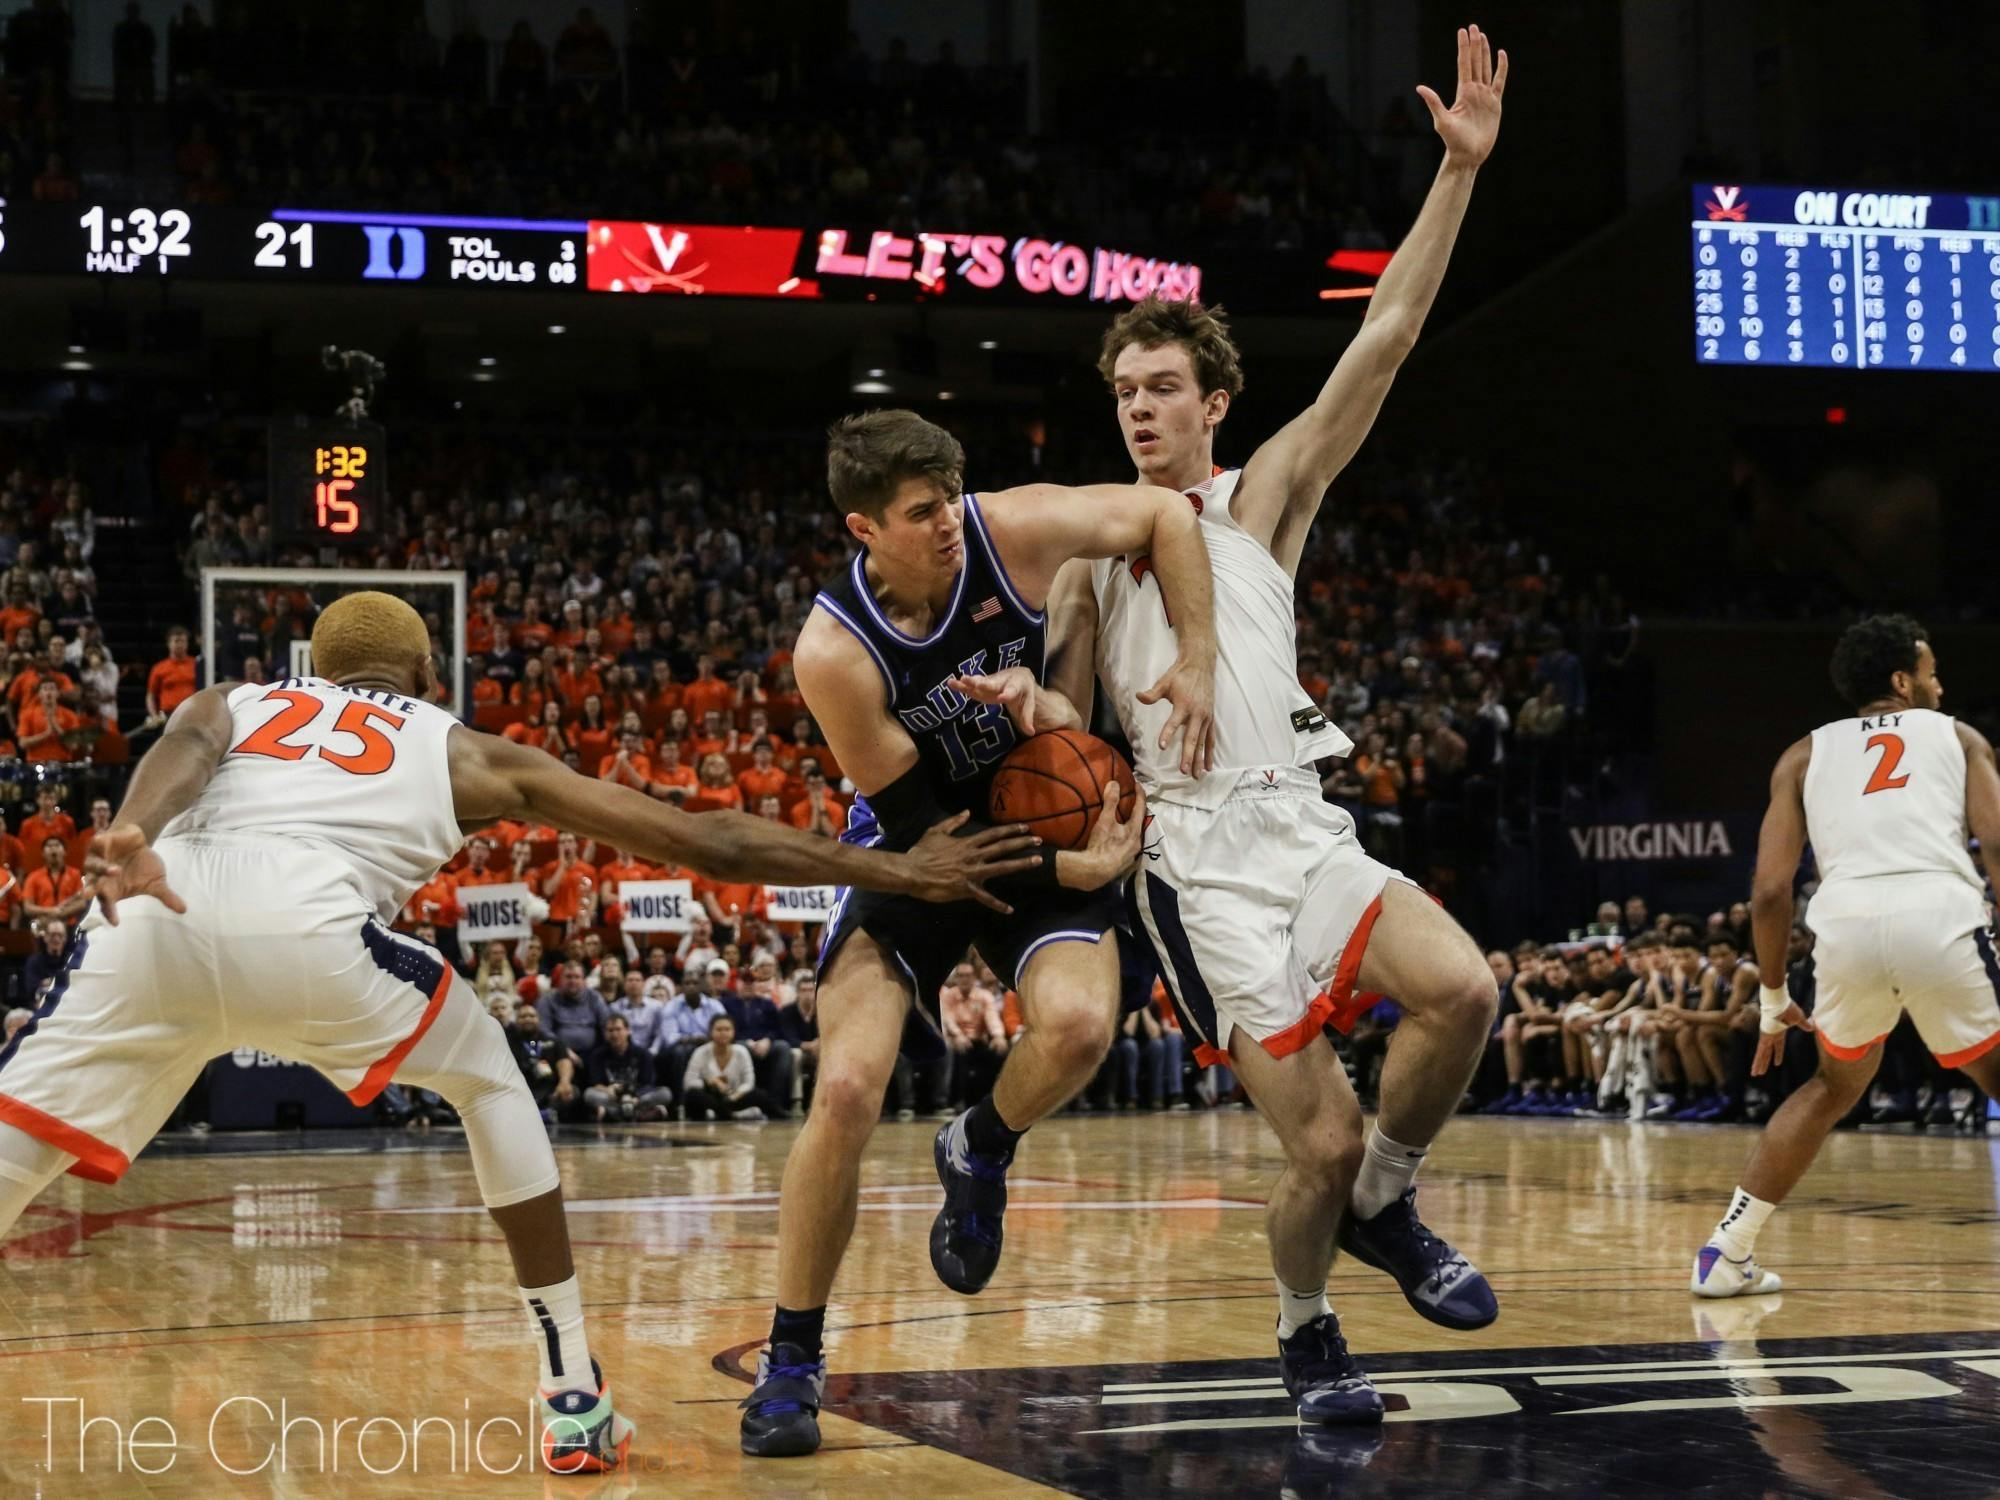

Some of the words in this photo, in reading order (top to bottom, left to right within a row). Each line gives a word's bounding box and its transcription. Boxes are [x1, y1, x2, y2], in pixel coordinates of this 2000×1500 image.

[1795, 191, 1838, 226] ON
[1842, 193, 1931, 229] COURT
[80, 206, 192, 256] 1:32
[254, 222, 313, 268] 21
[448, 237, 500, 258] TOL
[561, 240, 575, 261] 3
[86, 252, 141, 273] HALF
[158, 254, 167, 274] 1
[1012, 237, 1089, 296] GO
[1699, 245, 1717, 265] 0
[1740, 246, 1758, 267] 0
[1785, 248, 1800, 268] 2
[1830, 249, 1842, 270] 1
[1865, 250, 1880, 271] 2
[1904, 252, 1921, 273] 0
[1949, 254, 1961, 274] 1
[451, 259, 535, 282] FOULS
[1742, 270, 1757, 291] 2
[1785, 272, 1801, 292] 2
[1829, 273, 1846, 294] 0
[1905, 276, 1921, 296] 4
[1950, 278, 1961, 298] 1
[1786, 295, 1802, 316] 3
[1832, 297, 1843, 317] 1
[1906, 300, 1923, 320] 0
[1951, 301, 1962, 321] 1
[1739, 317, 1763, 338] 10
[1786, 319, 1803, 339] 4
[1833, 319, 1844, 340] 1
[1907, 322, 1924, 343] 0
[1949, 323, 1967, 344] 0
[1703, 339, 1719, 360] 2
[1744, 340, 1761, 361] 6
[1831, 343, 1848, 363] 0
[1868, 343, 1884, 364] 3
[1908, 345, 1924, 365] 7
[1950, 346, 1967, 367] 4
[316, 446, 367, 478] 1:32
[316, 480, 359, 533] 15
[229, 689, 405, 775] 25
[1861, 714, 1903, 731] KEY
[936, 700, 1017, 782] 13
[1862, 733, 1910, 796] 2
[1569, 821, 1732, 860] VIRGINIA
[630, 894, 683, 919] NOISE
[775, 888, 828, 910] NOISE
[467, 899, 521, 928] NOISE
